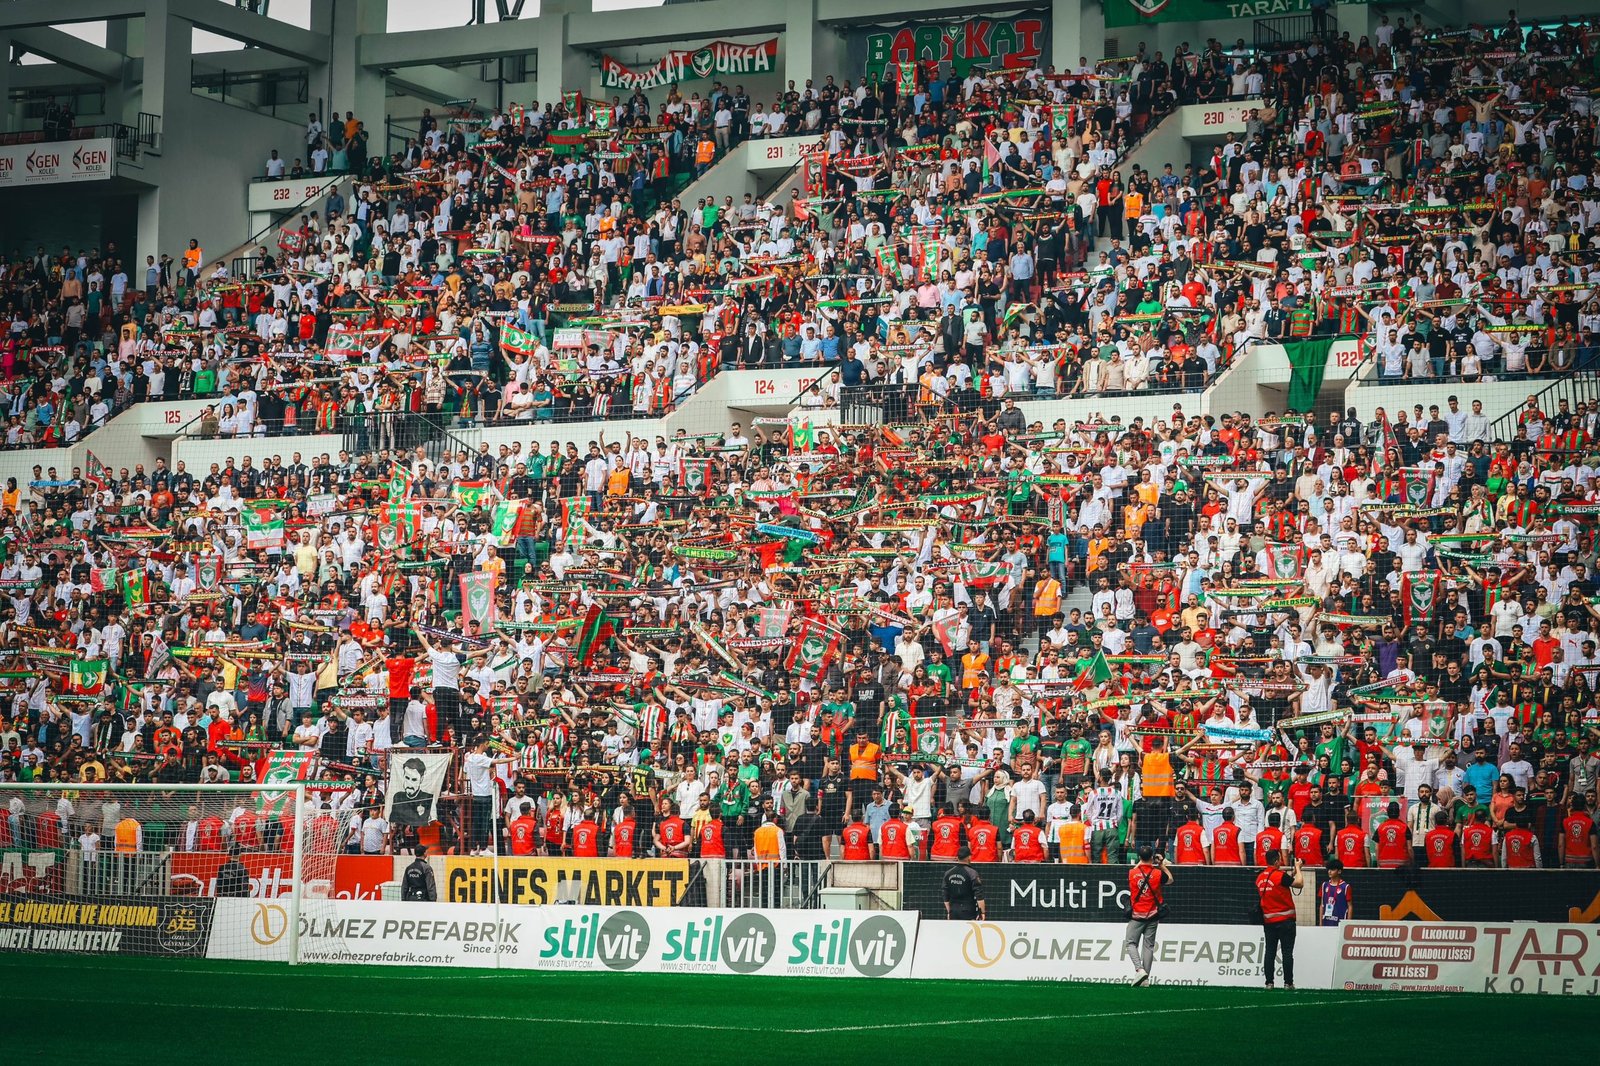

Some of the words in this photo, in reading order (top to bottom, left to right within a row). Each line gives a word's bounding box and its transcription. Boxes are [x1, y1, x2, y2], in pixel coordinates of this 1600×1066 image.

[715, 43, 770, 74] URFA
[1204, 111, 1224, 125] 230
[82, 151, 107, 165] GEN
[767, 146, 783, 159] 231
[0, 158, 13, 172] EN
[35, 154, 60, 168] GEN
[273, 188, 290, 200] 232
[305, 185, 321, 198] 231
[1336, 351, 1358, 367] 122
[754, 380, 776, 394] 124
[164, 410, 181, 423] 125
[957, 491, 984, 501] SPOR
[1406, 509, 1442, 517] AMEDSPOR
[1564, 505, 1600, 514] AMEDSP
[686, 547, 725, 558] AMEDSPOR
[1274, 597, 1314, 607] AMEDSPOR
[738, 639, 783, 647] AMEDSPOR
[192, 649, 211, 657] SPOR
[1036, 688, 1081, 697] AMEDSPOR
[340, 699, 377, 708] AMEDSPOR
[1087, 698, 1130, 711] AMEDSPOR
[504, 718, 543, 730] BARIKAT
[913, 722, 943, 730] ŞAMPİYON
[1396, 736, 1441, 745] AMEDSPOR
[268, 755, 309, 764] ŞAMPİYON
[1245, 760, 1302, 768] AMEDSPOR
[330, 782, 352, 790] SPOR
[634, 776, 649, 795] 21
[1099, 802, 1114, 819] 21
[556, 868, 684, 907] MARKET
[1010, 878, 1087, 908] Multi
[13, 901, 79, 924] GÜVENLİK
[80, 903, 98, 925] VE
[98, 904, 158, 926] KORUMA
[298, 912, 376, 939] ÖLMEZ
[383, 918, 521, 943] PREFABRİK
[1352, 927, 1400, 939] ANAOKULU
[33, 928, 122, 951] VERMEKTEYİZ
[1421, 928, 1466, 940] İLKOKULU
[463, 943, 492, 953] Since
[494, 944, 518, 955] 1996
[1010, 932, 1112, 961] ÖLMEZ
[1347, 946, 1401, 957] ORTAOKULU
[1483, 928, 1600, 976] TAR
[303, 950, 455, 964] www.olmezprefabrik.com.tr
[1412, 948, 1448, 959] ANADOLU
[1448, 948, 1472, 960] LİSESİ
[1218, 965, 1251, 976] Since
[1382, 966, 1398, 977] FEN
[1399, 966, 1429, 978] LİSESİ
[1484, 976, 1600, 995] KOLEJ
